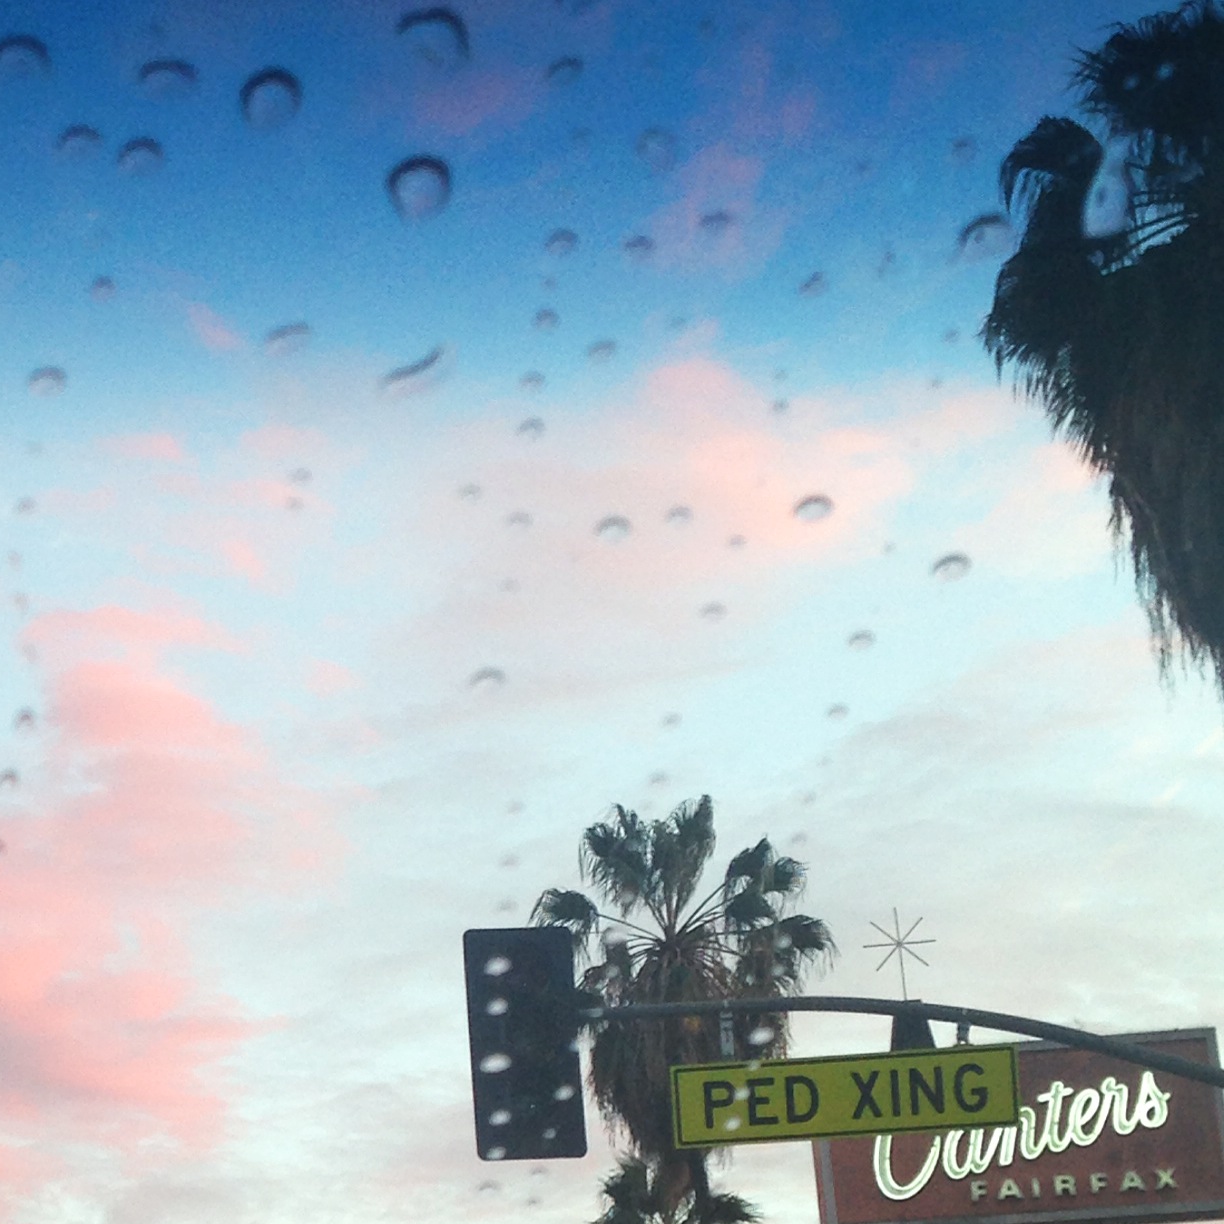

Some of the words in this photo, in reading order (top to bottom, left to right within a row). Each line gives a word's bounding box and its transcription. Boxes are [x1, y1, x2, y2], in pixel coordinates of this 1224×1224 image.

[702, 1075, 819, 1129] PED
[851, 1063, 989, 1120] XING
[971, 1167, 1177, 1202] FAIRFAX
